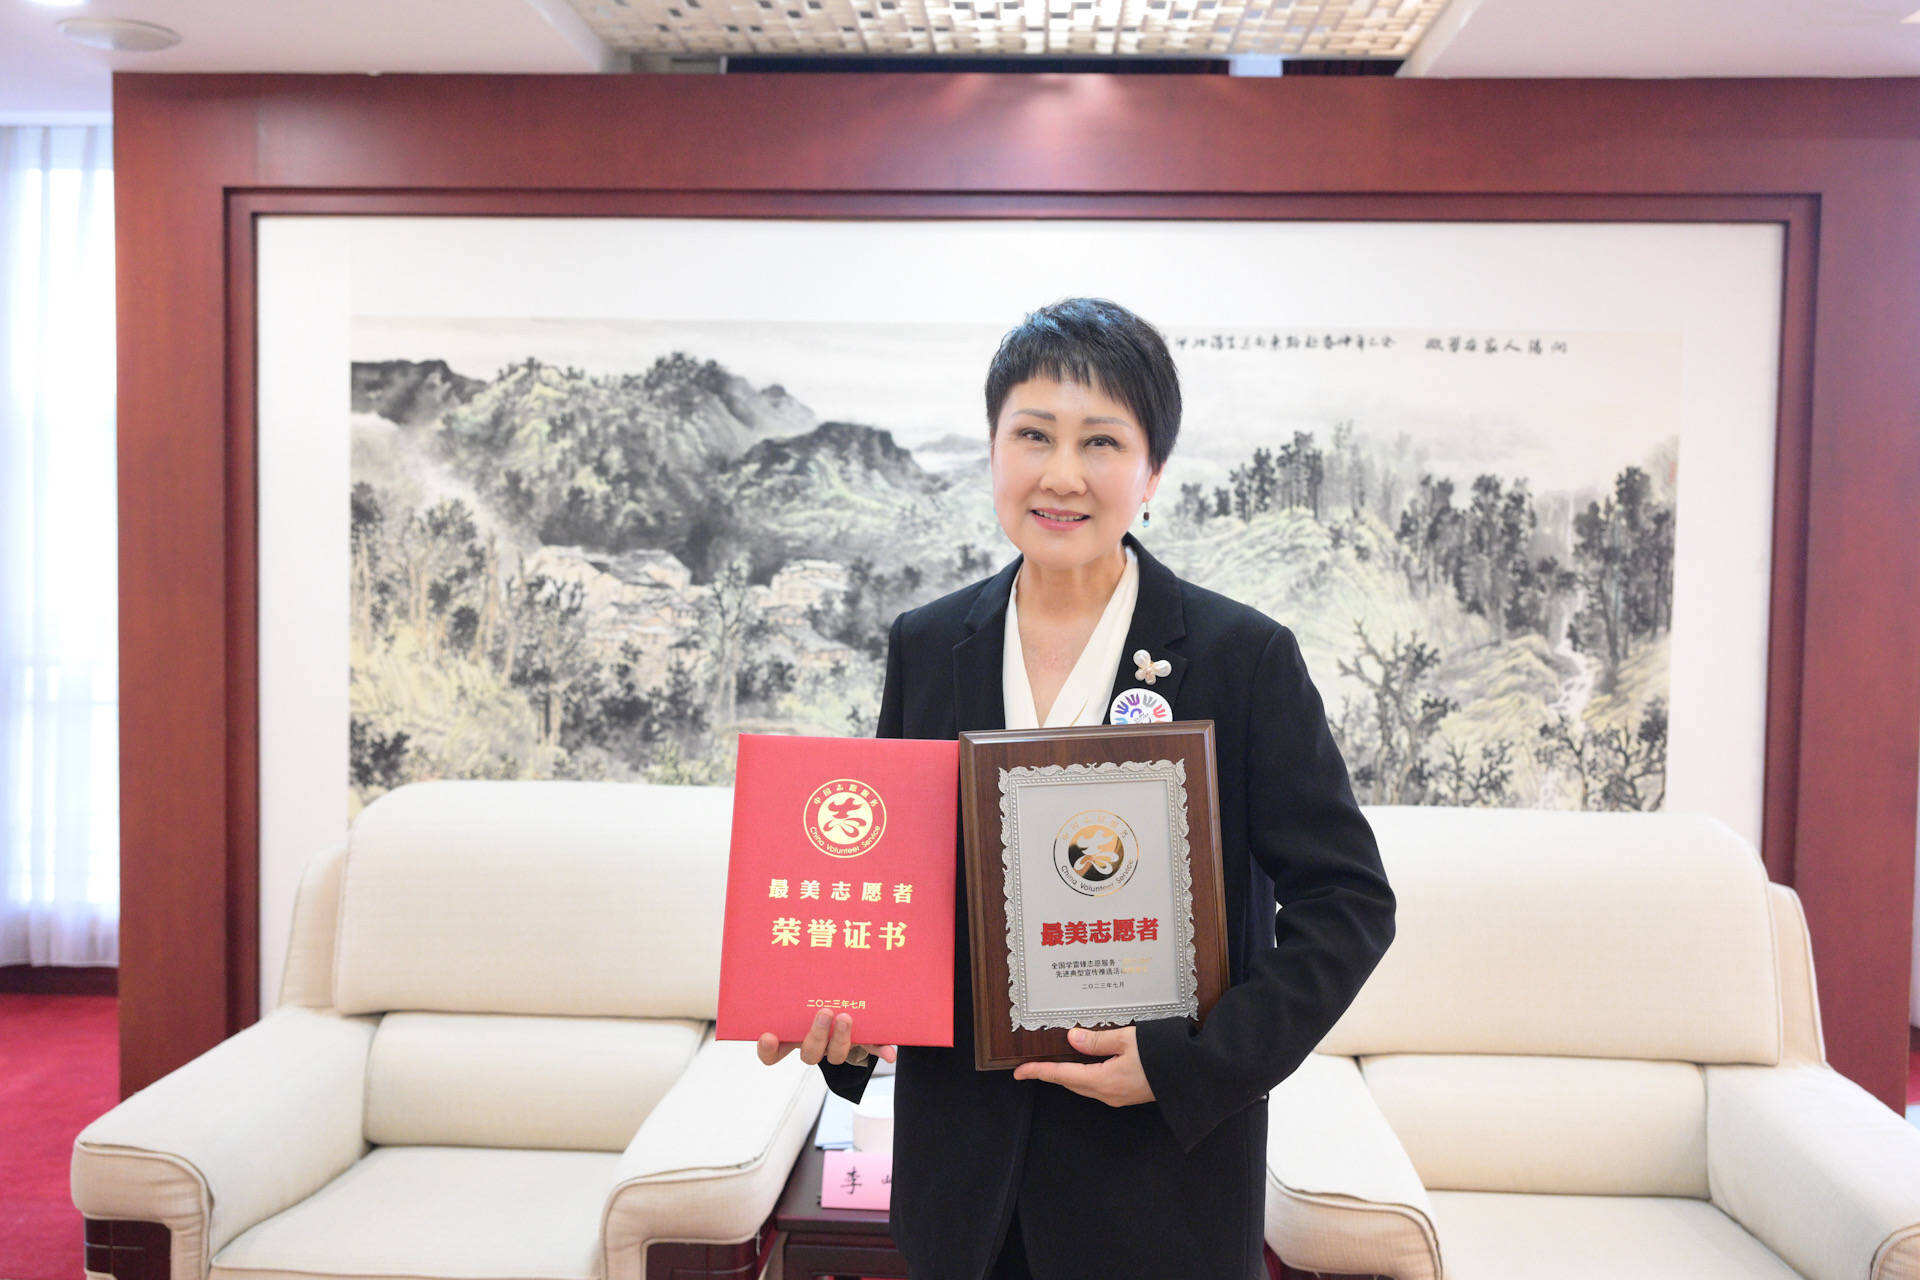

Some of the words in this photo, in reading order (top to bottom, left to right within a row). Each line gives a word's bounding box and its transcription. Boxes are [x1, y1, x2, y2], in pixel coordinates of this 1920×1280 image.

[768, 878, 913, 904] 最美志愿者
[771, 917, 908, 951] 荣誉证书
[1041, 918, 1159, 946] 最美志愿者
